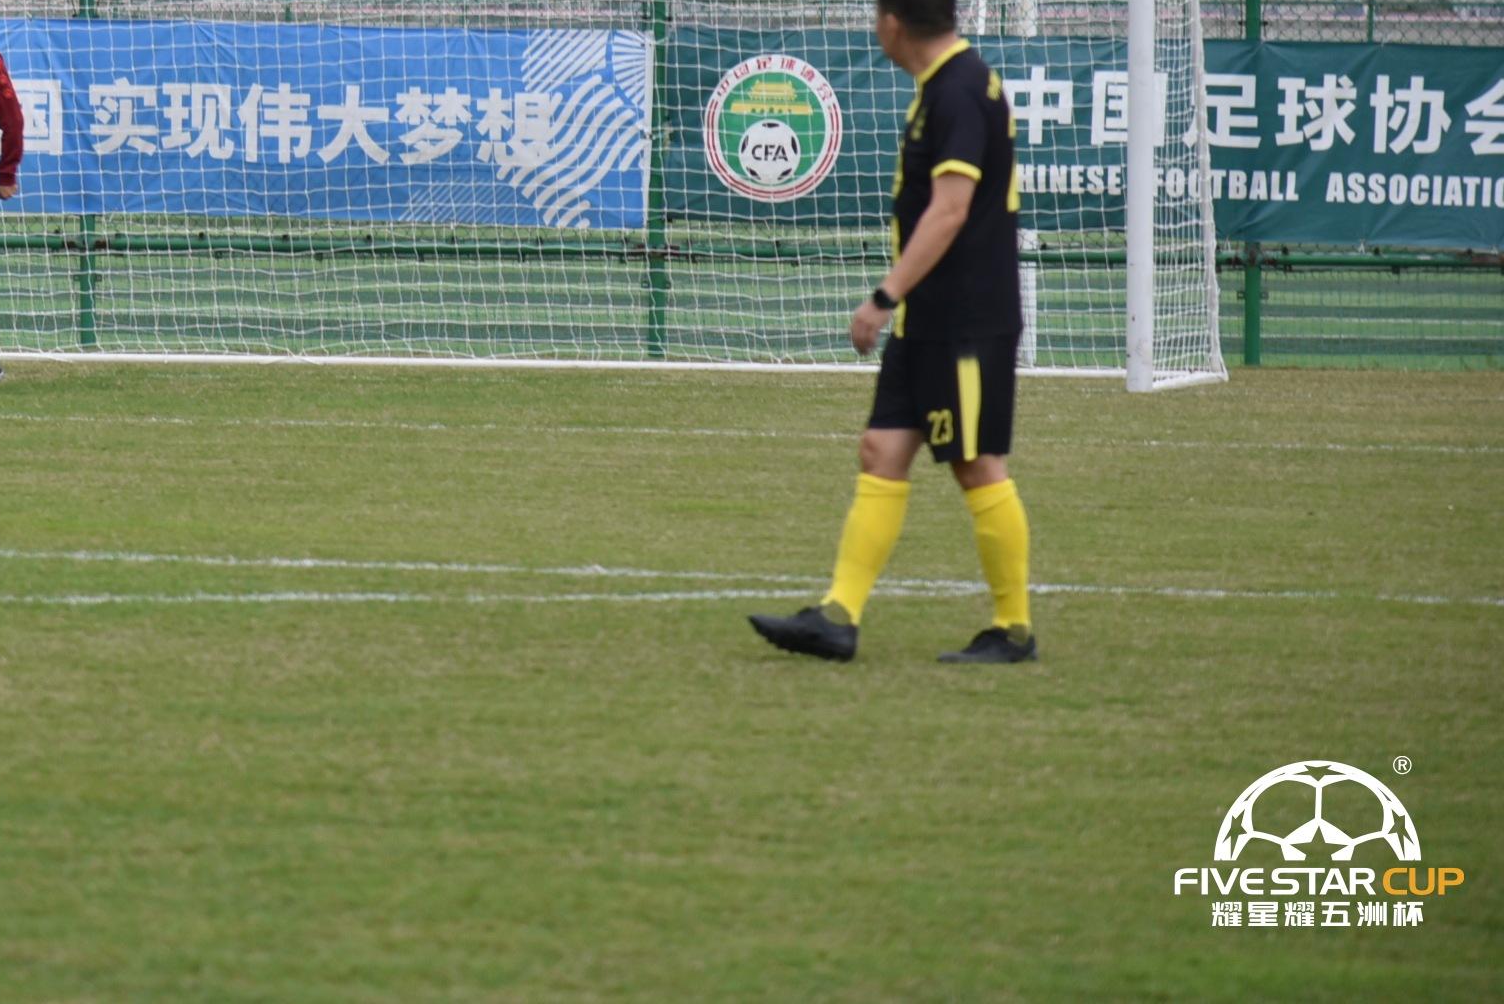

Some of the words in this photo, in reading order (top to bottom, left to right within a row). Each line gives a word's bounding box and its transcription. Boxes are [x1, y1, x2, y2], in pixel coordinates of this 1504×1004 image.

[89, 77, 556, 165] 实现伟大梦想
[751, 144, 788, 161] CFA
[1012, 163, 1123, 195] HINESE
[1153, 167, 1300, 202] FOOTBALL
